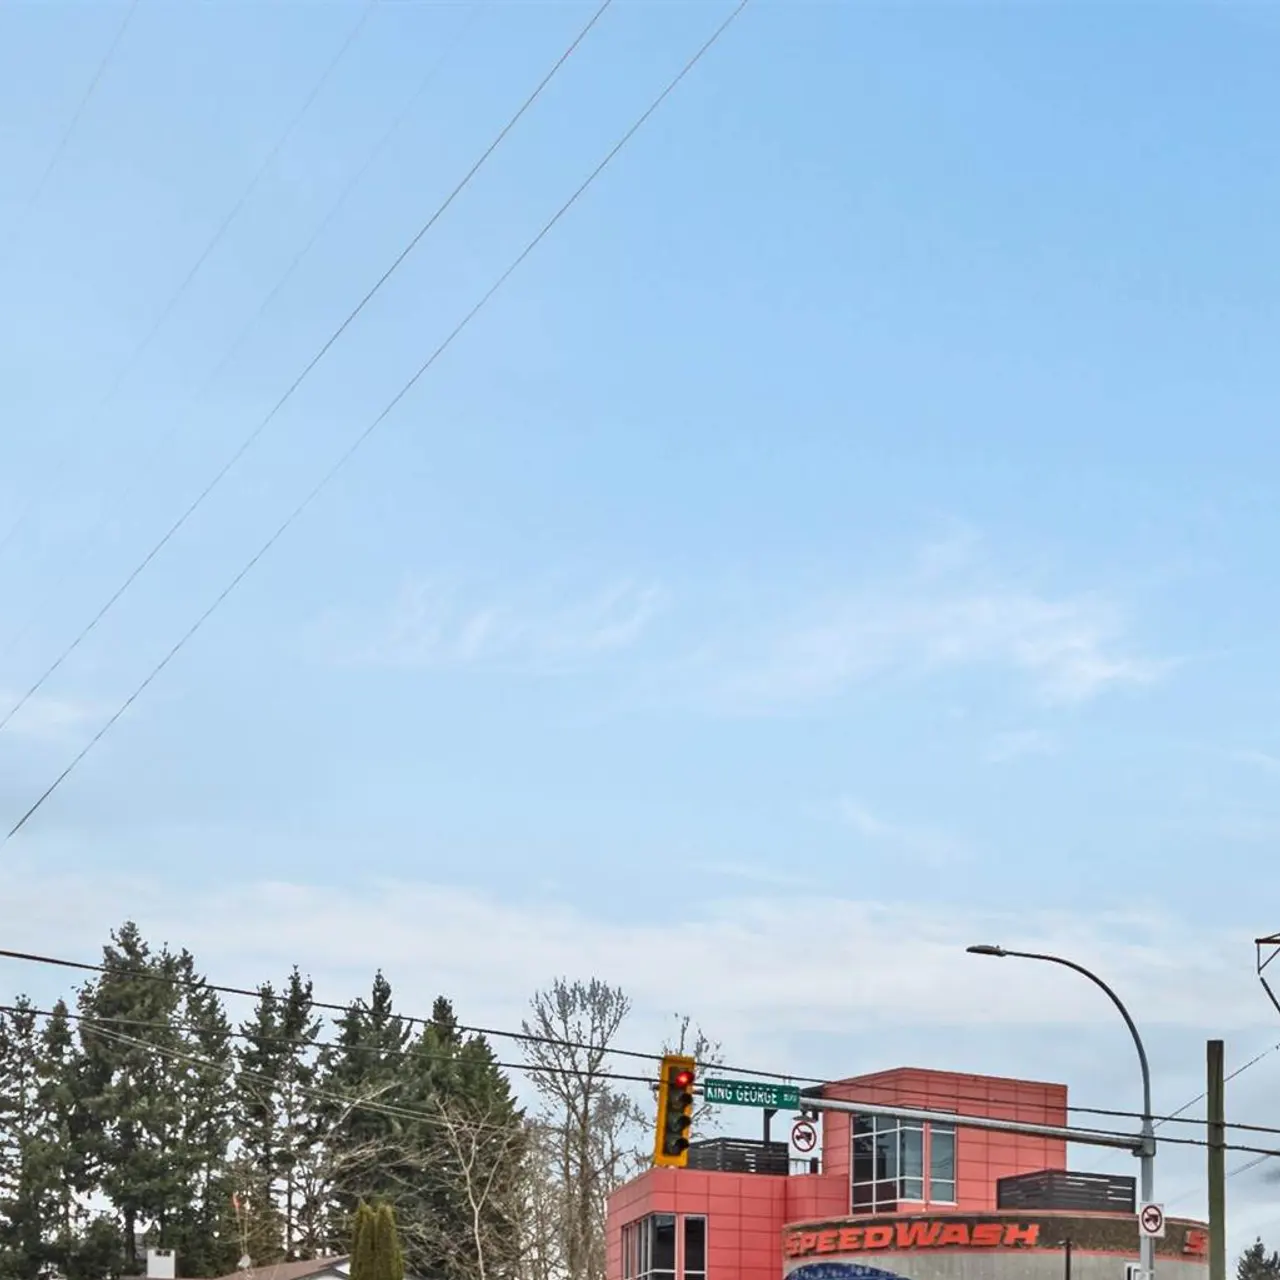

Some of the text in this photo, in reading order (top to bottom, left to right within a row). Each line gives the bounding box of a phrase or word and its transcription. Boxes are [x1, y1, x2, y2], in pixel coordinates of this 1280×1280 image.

[706, 1083, 733, 1101] KING
[735, 1085, 779, 1105] GEORGE
[785, 1222, 1039, 1257] SPEEDWASH
